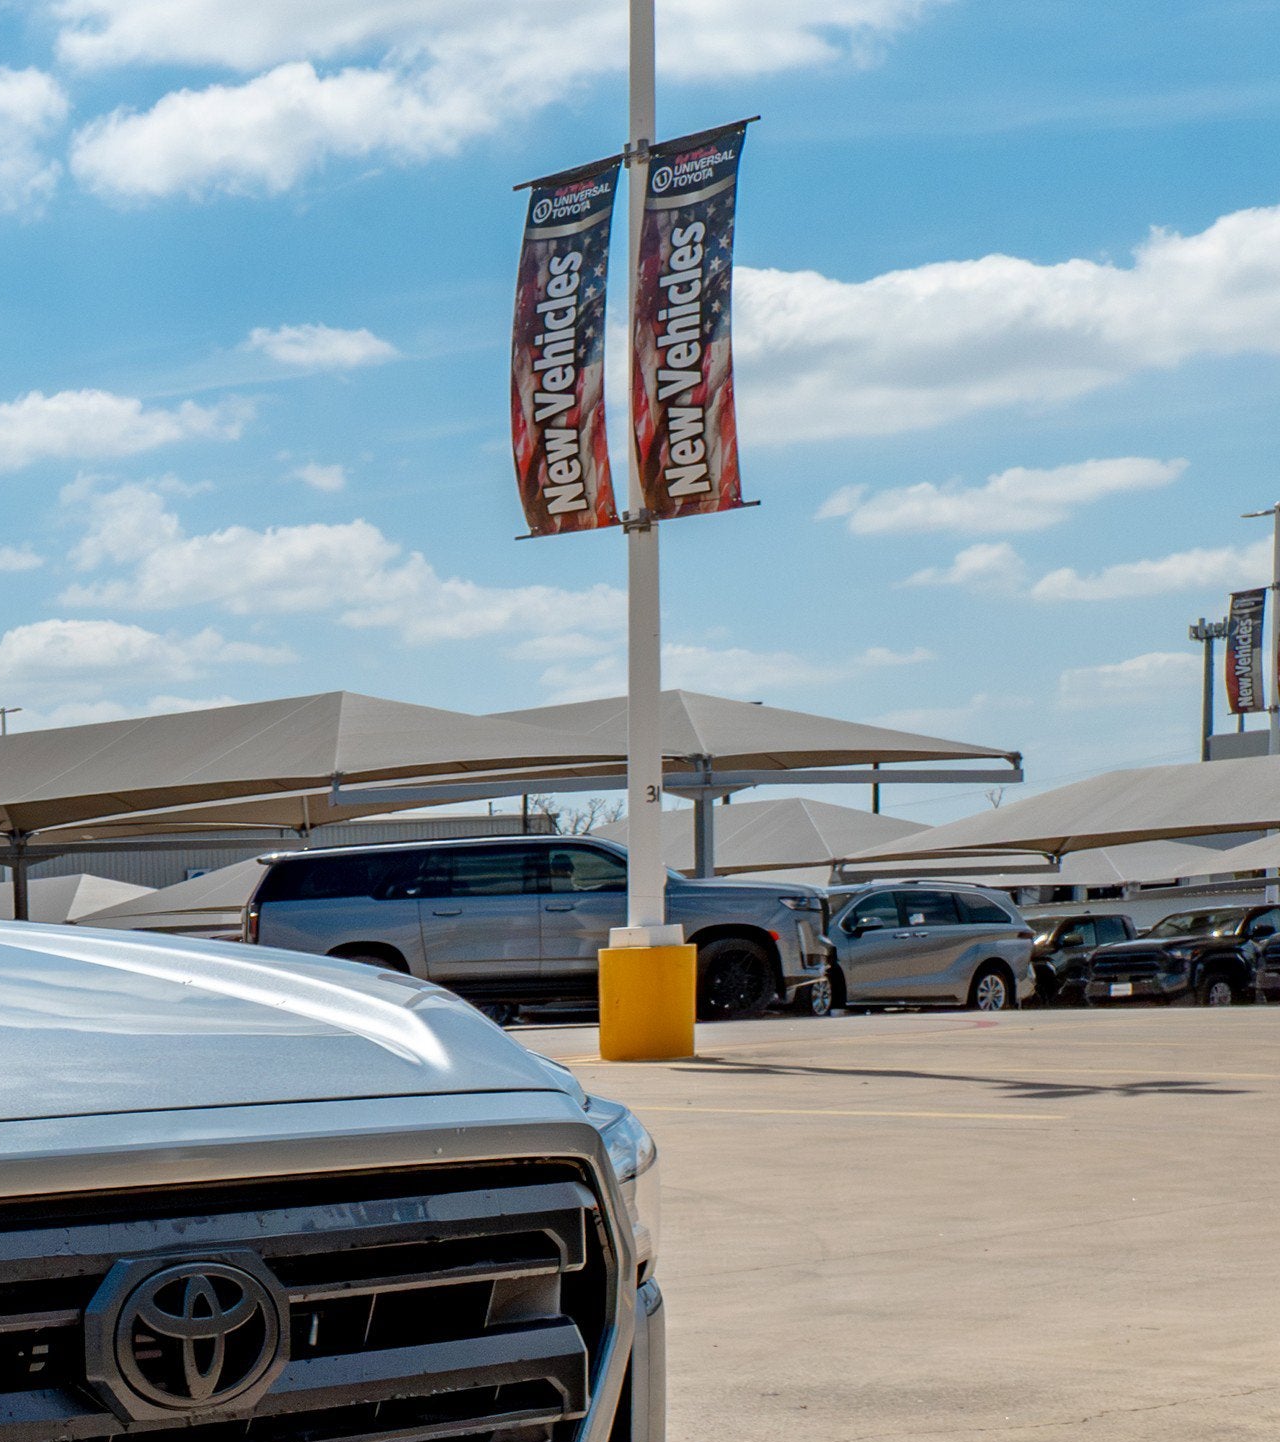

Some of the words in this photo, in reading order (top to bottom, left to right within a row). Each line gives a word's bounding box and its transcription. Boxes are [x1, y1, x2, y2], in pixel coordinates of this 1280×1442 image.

[673, 167, 713, 188] TOYOTA
[674, 149, 735, 176] UNIVERSAL
[552, 200, 591, 220] TOYOTA
[554, 182, 611, 208] UNIVERSAL
[656, 220, 706, 403] Vehicles
[533, 250, 583, 423] Vehicles
[665, 406, 711, 499] New
[542, 425, 590, 515] New
[1235, 618, 1252, 677] Vehicles
[1238, 677, 1254, 707] New
[646, 784, 660, 803] 31
